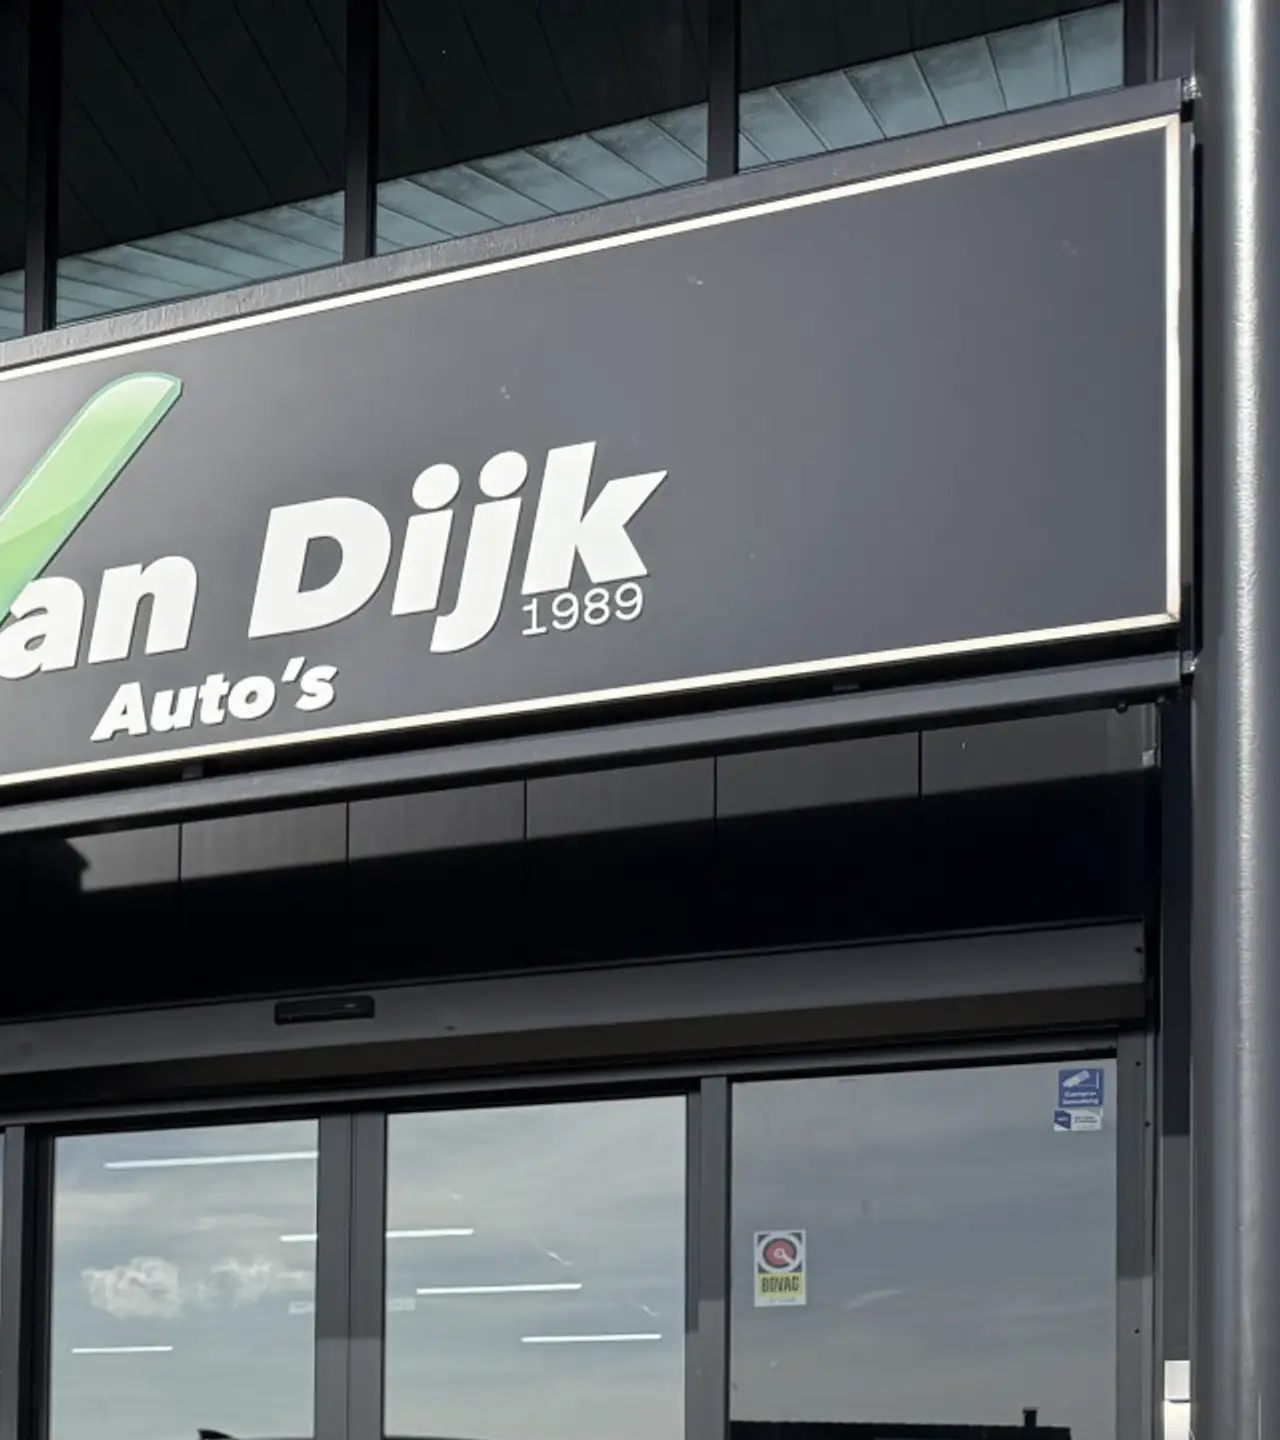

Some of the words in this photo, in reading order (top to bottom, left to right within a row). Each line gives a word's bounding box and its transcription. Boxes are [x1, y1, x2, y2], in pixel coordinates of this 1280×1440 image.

[248, 441, 668, 653] Dijk
[521, 582, 644, 636] 1989
[90, 656, 338, 742] Auto's
[761, 1275, 801, 1293] BOVAG
